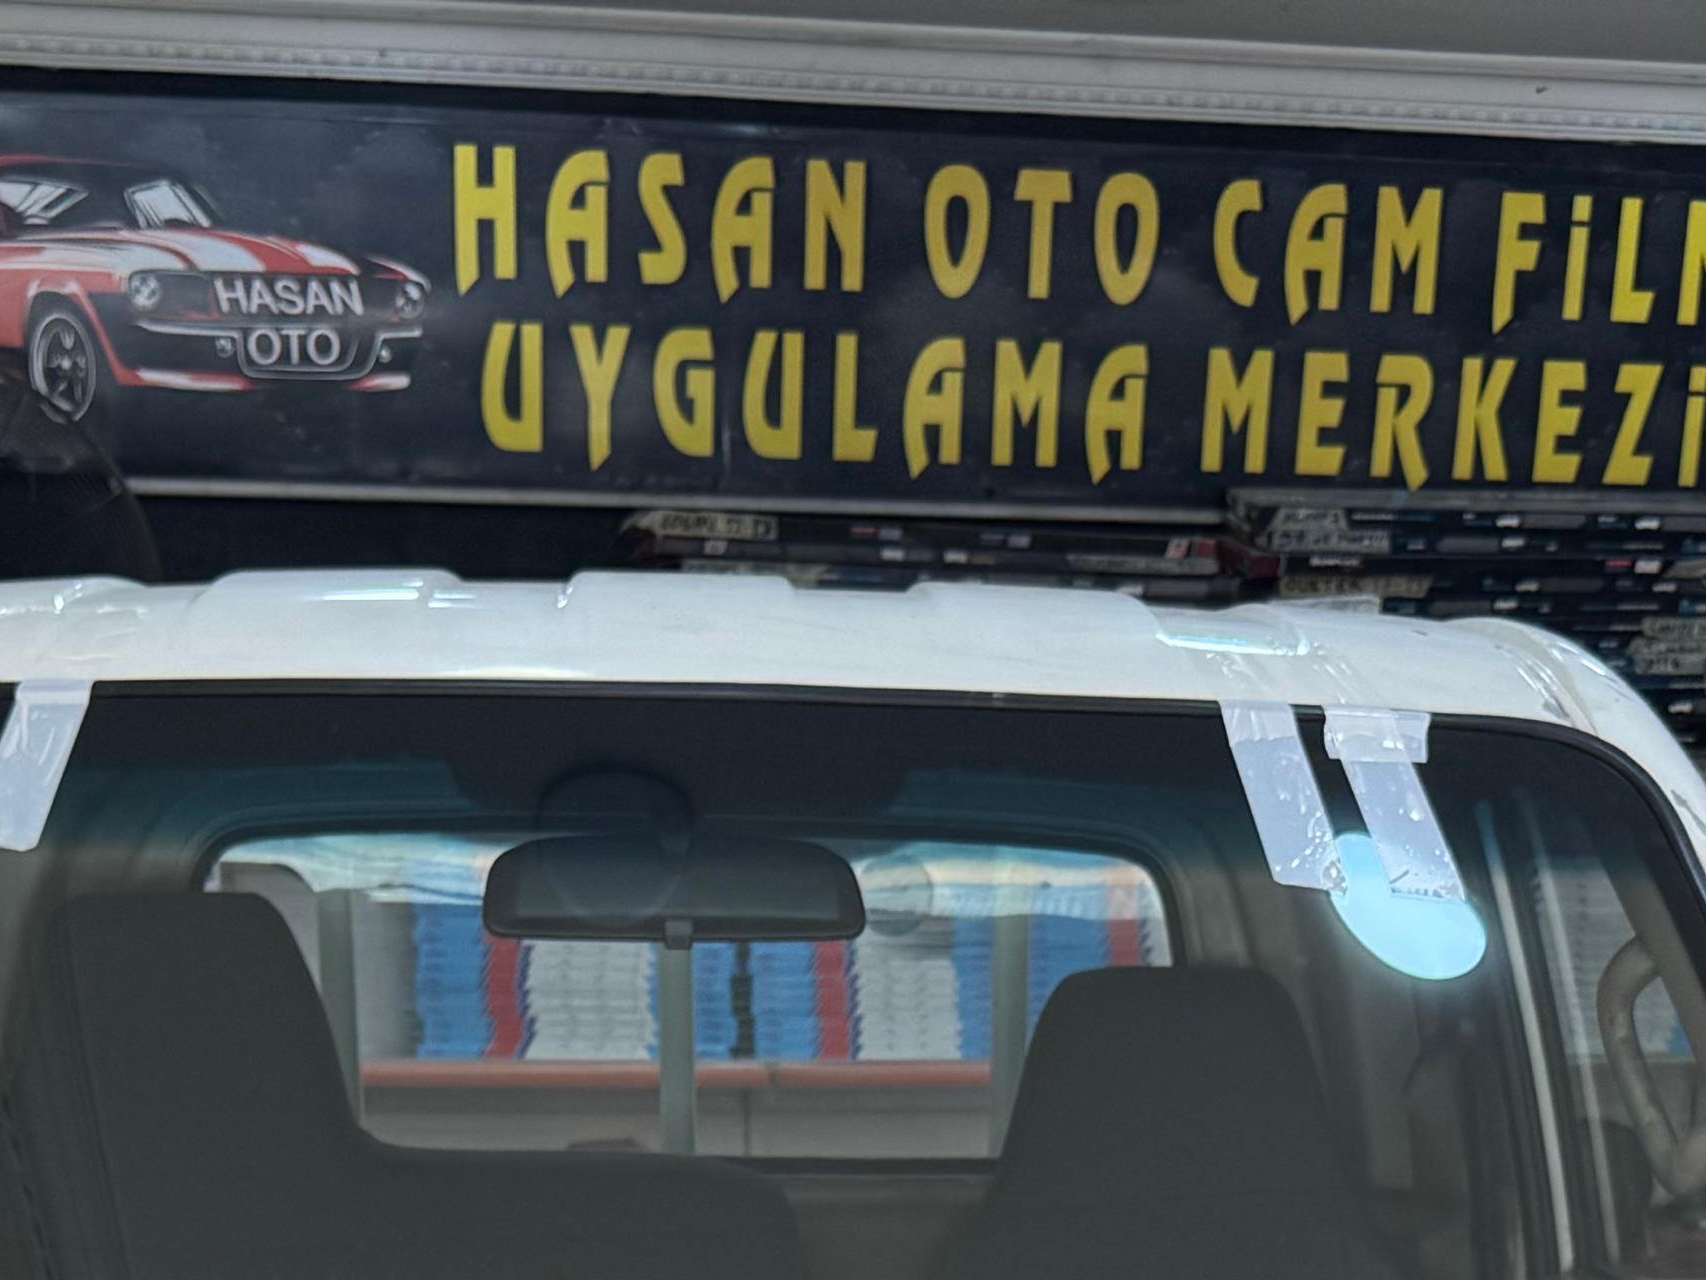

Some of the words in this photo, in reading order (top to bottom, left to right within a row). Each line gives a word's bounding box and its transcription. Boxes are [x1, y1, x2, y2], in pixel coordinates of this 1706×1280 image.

[454, 144, 866, 304] HASAN
[924, 164, 1160, 306] OTO
[1213, 179, 1444, 326] CAM
[213, 275, 365, 316] HASAN
[247, 328, 341, 366] OTO
[480, 321, 1149, 486] UYGULAMA
